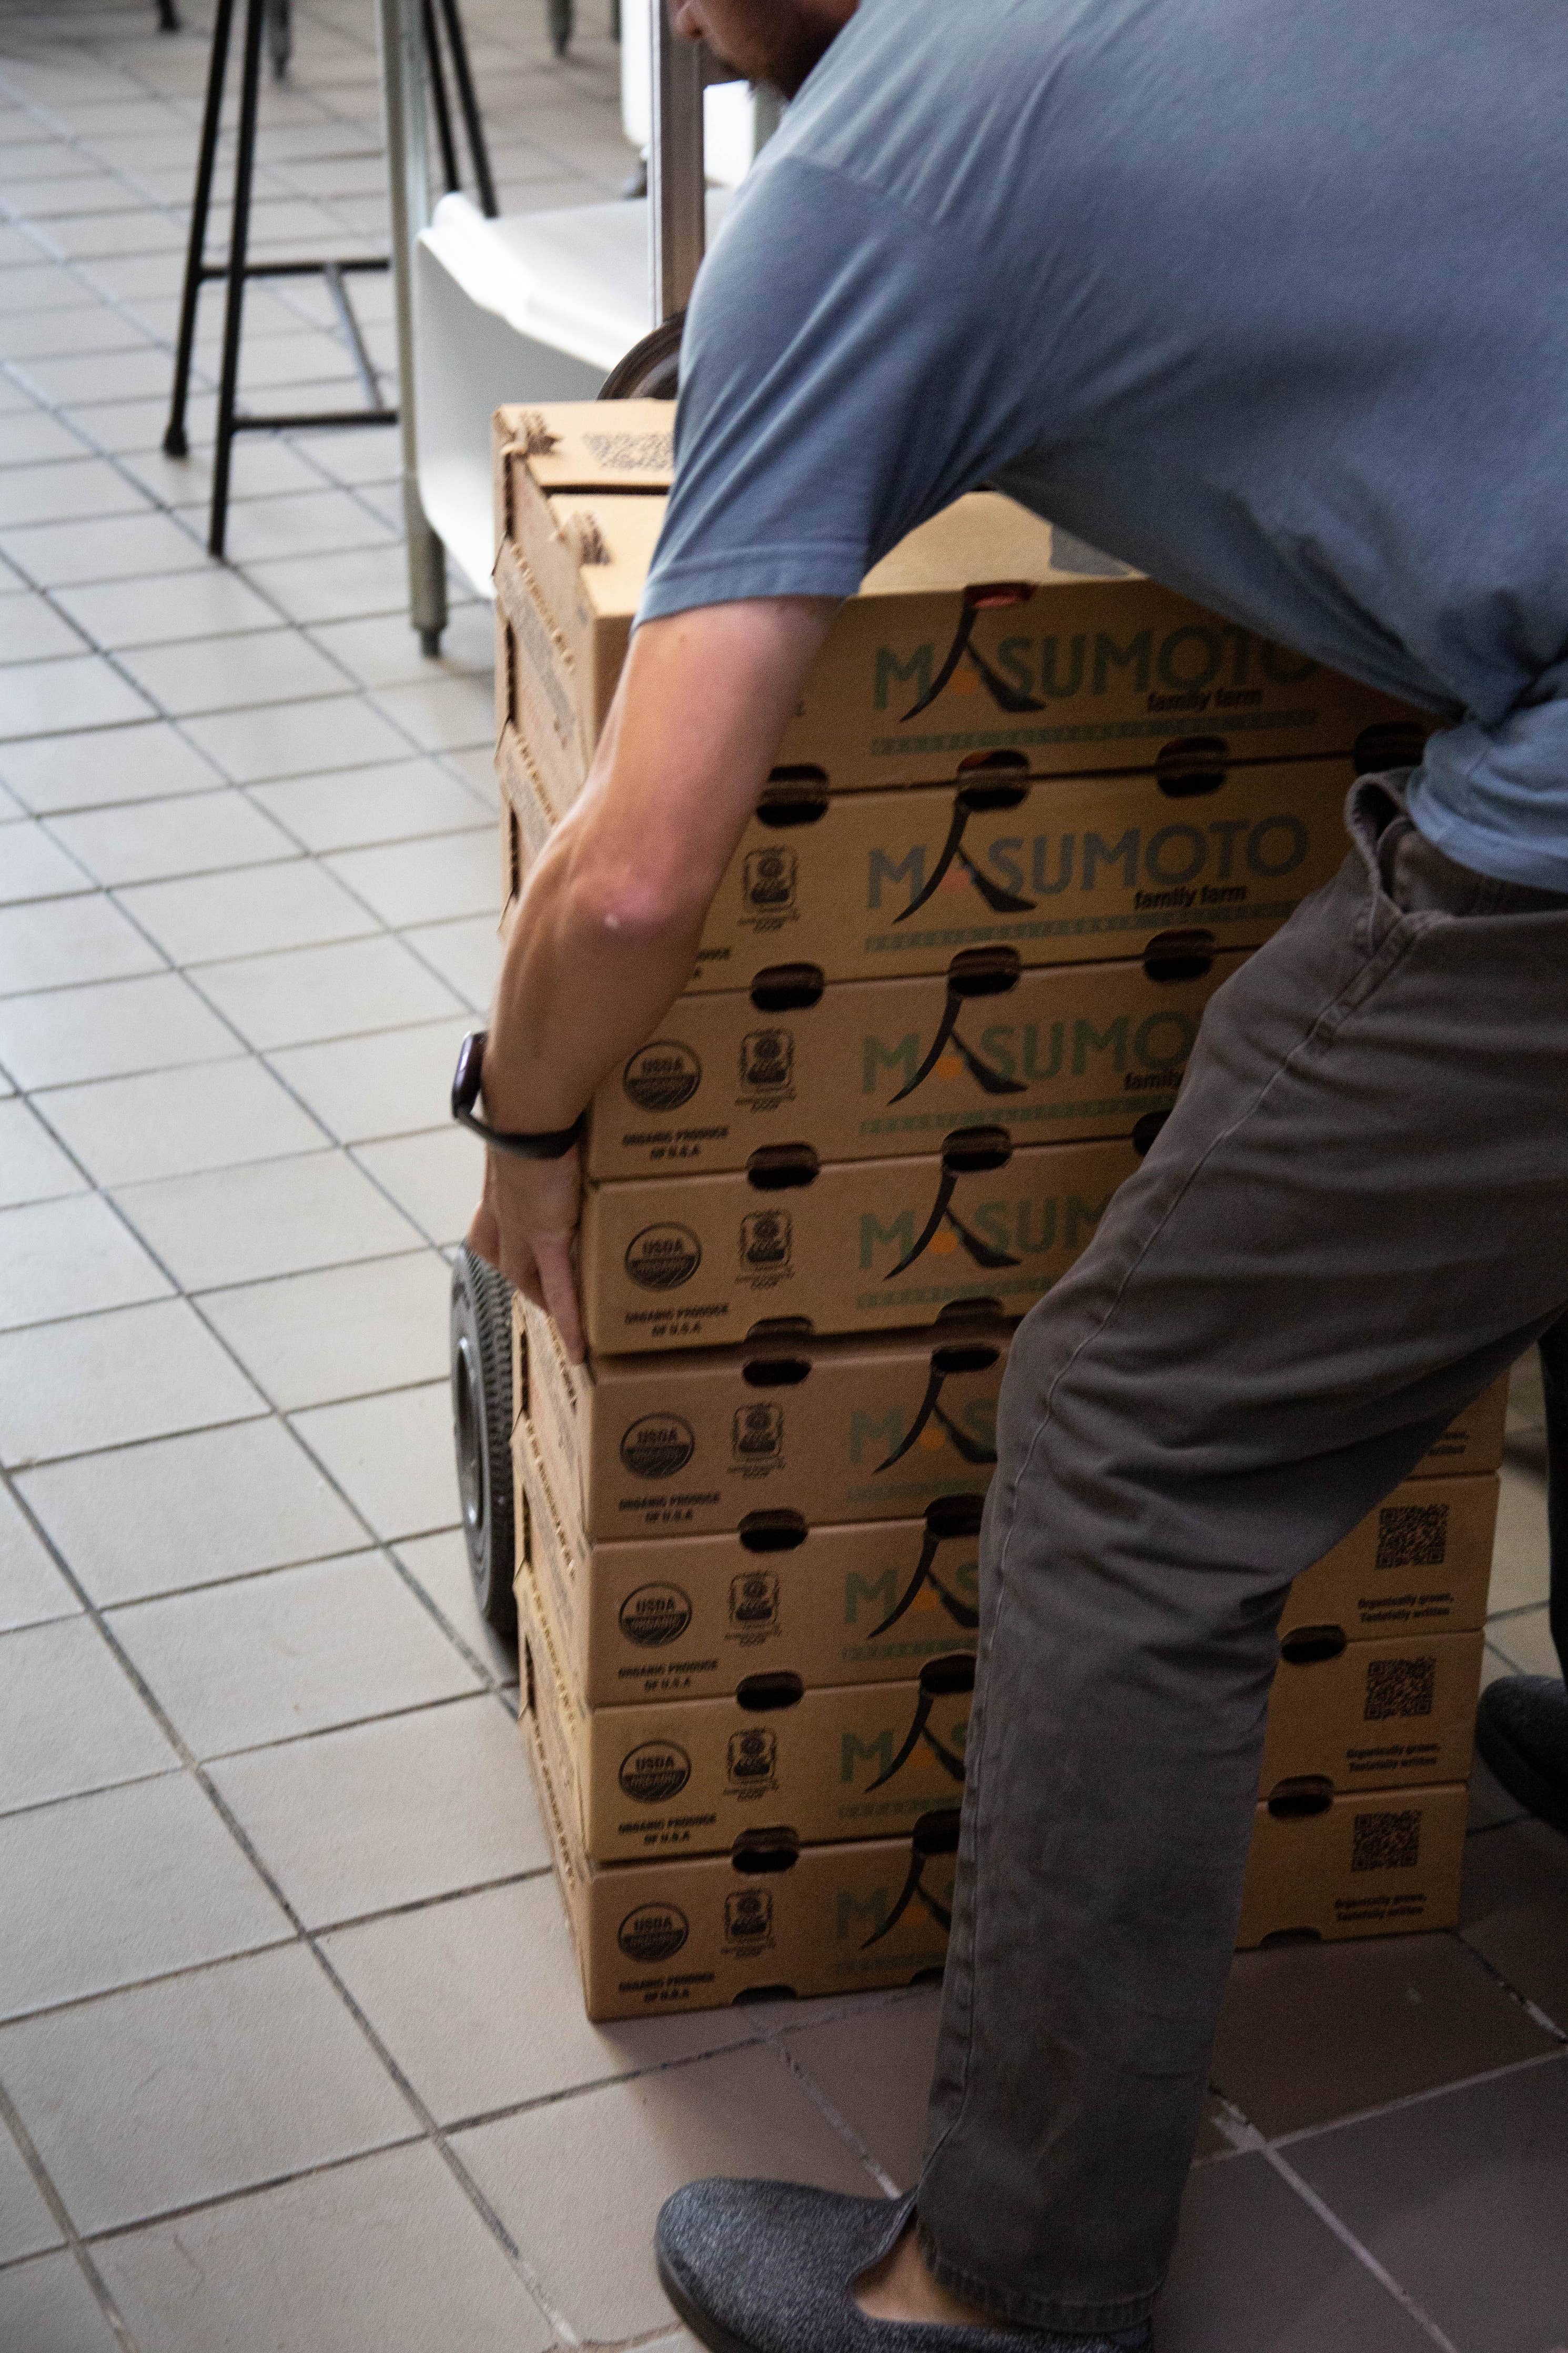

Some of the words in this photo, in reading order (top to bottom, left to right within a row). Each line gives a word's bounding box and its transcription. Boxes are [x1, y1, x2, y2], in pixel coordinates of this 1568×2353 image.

[1148, 690, 1211, 712] family
[1214, 687, 1263, 708] farm
[1134, 886, 1197, 911] family
[1200, 884, 1248, 905] farm
